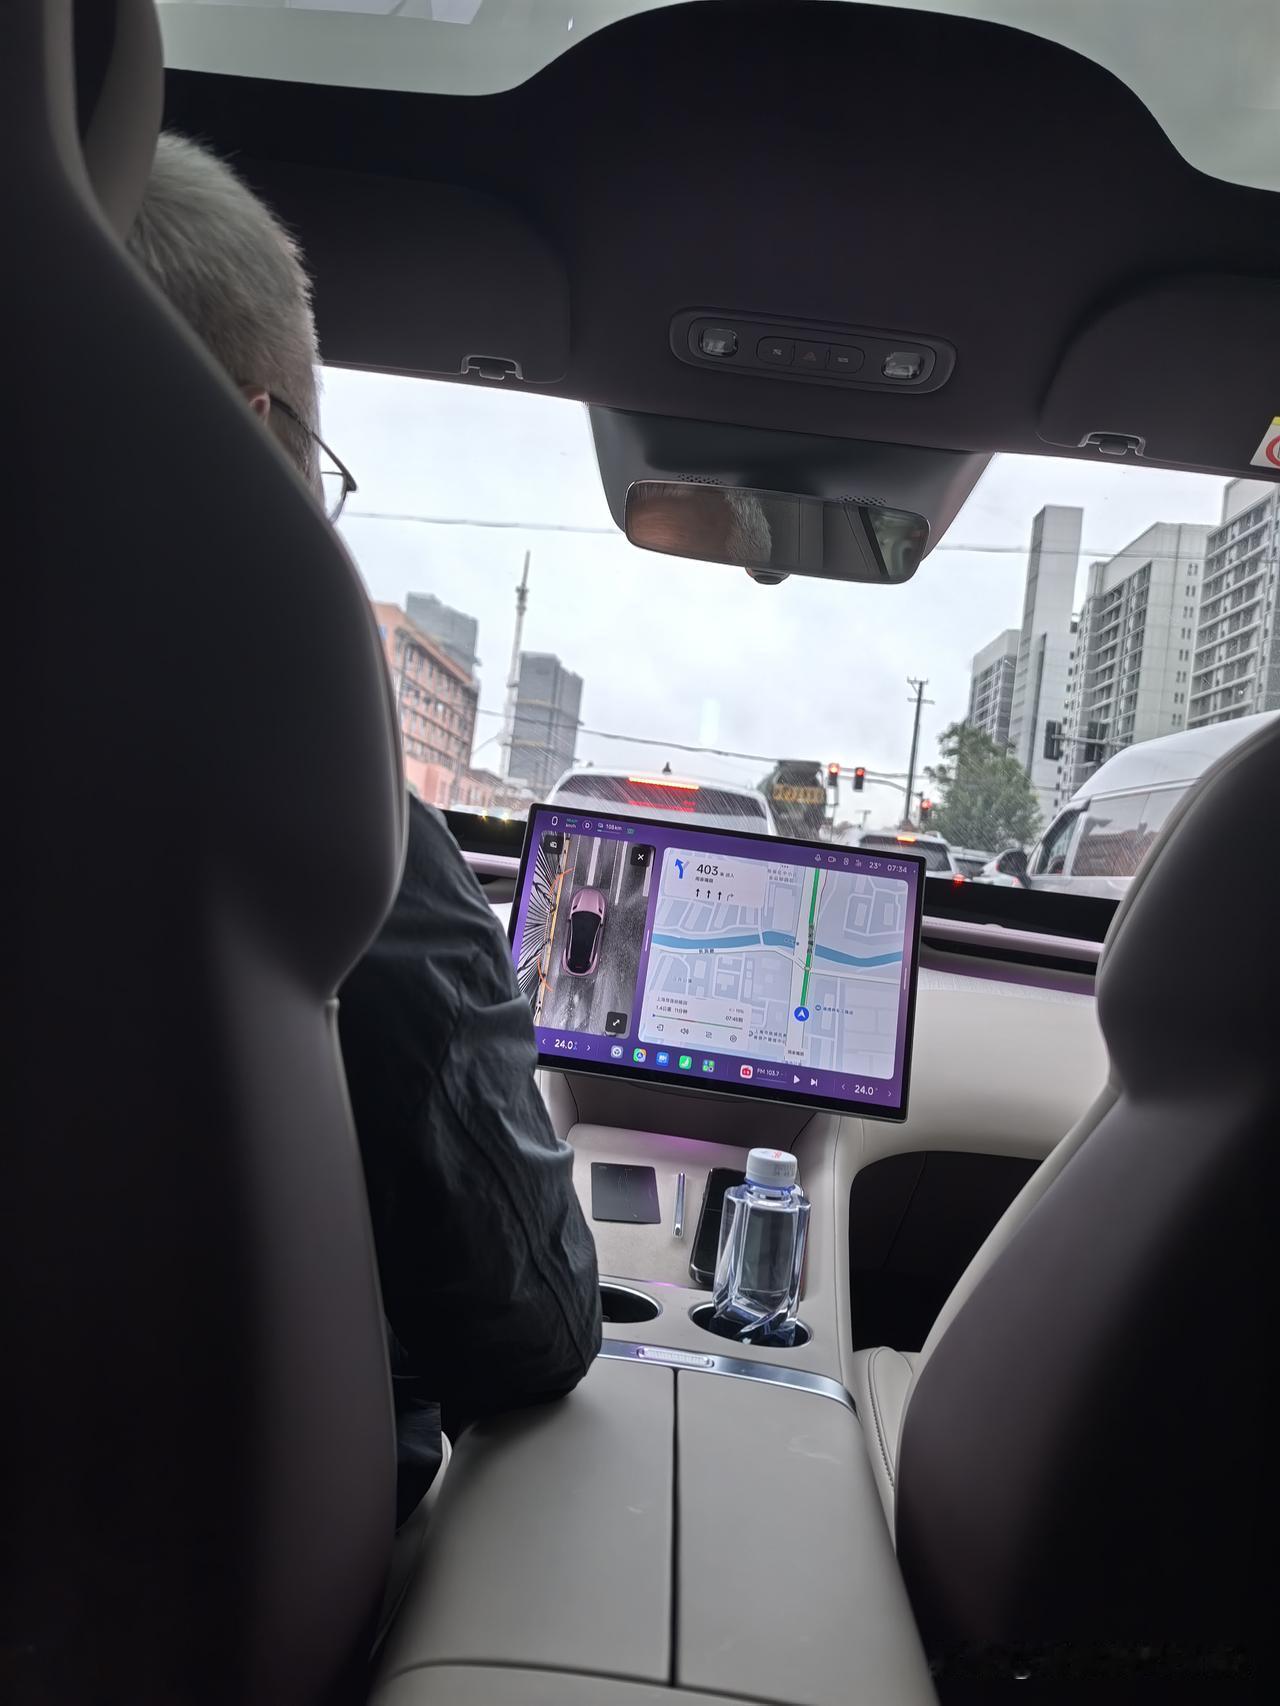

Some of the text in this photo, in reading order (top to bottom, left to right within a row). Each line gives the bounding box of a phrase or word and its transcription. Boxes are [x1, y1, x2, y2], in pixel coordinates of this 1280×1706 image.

[551, 816, 559, 826] 0
[695, 863, 719, 876] 403
[886, 864, 908, 873] 07:34
